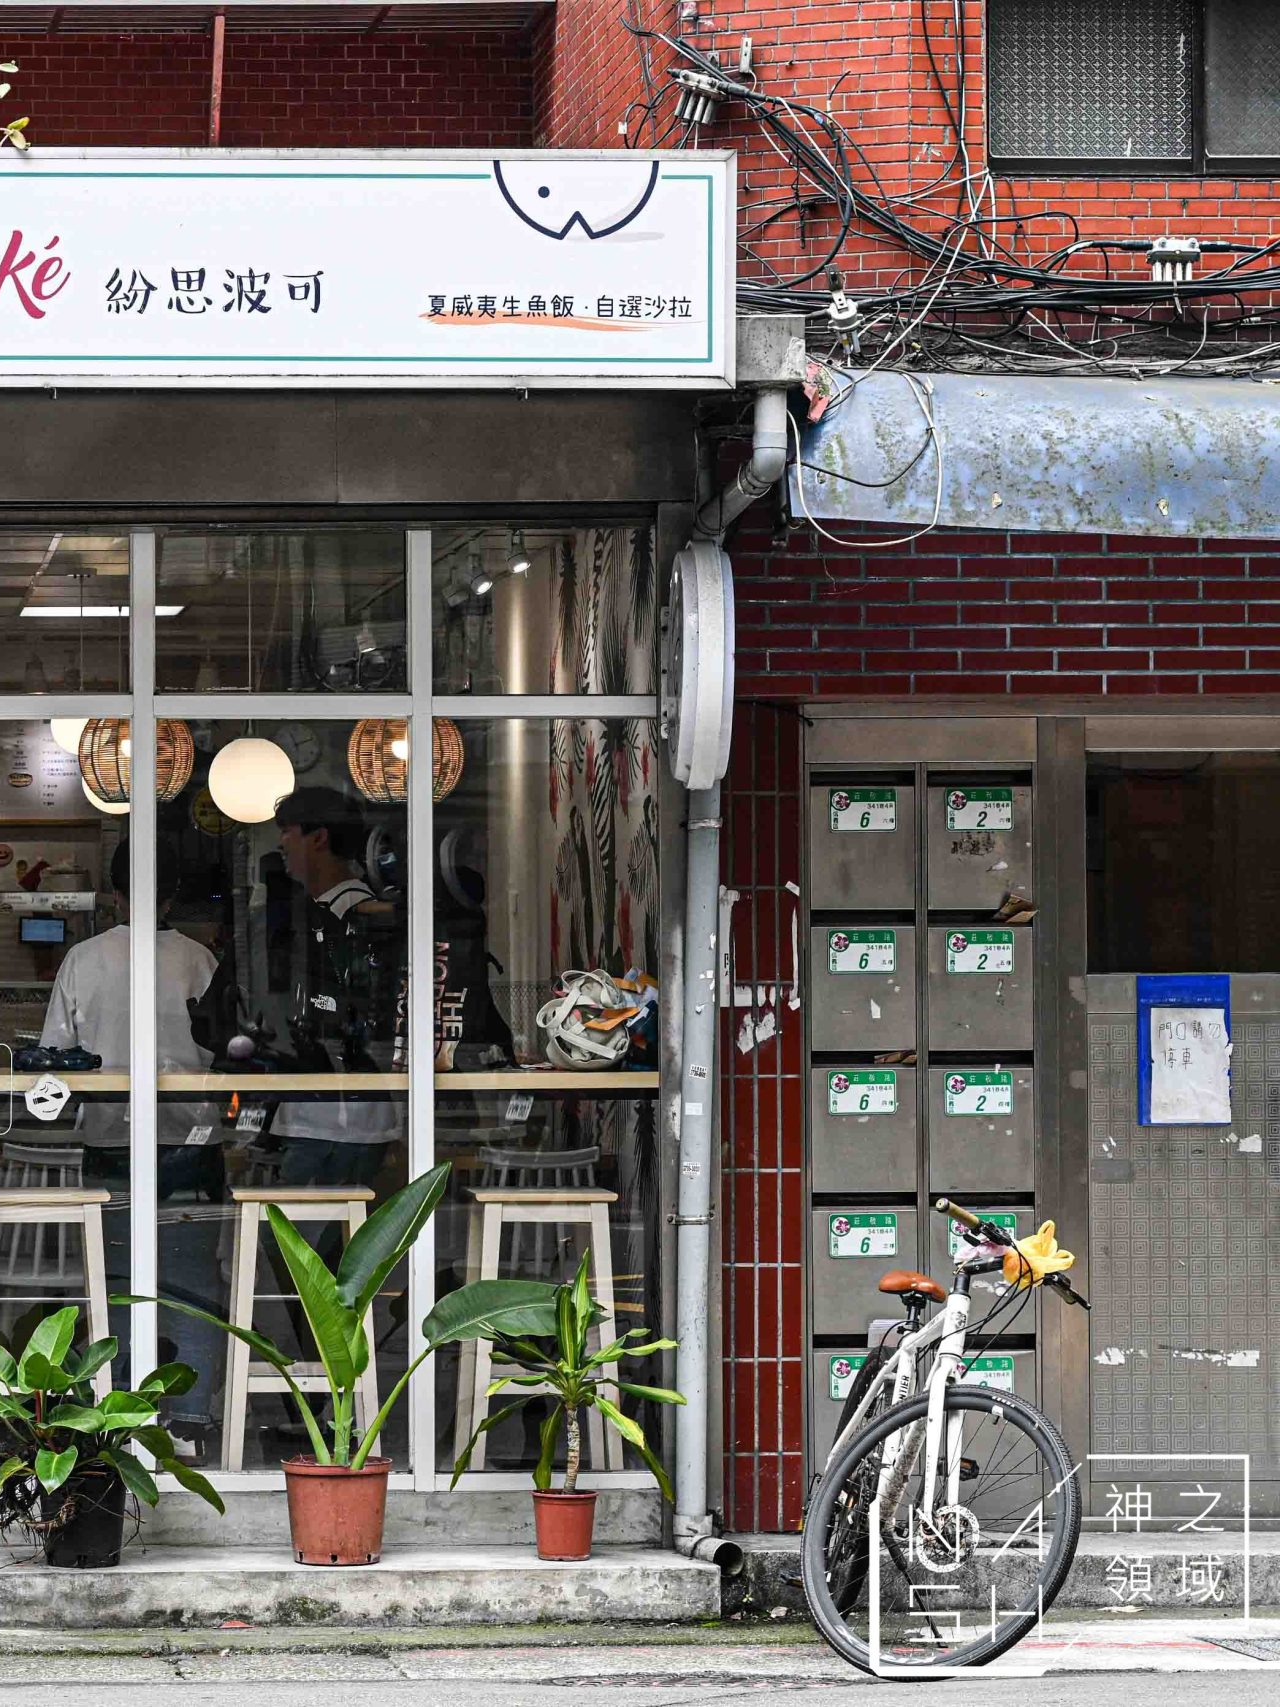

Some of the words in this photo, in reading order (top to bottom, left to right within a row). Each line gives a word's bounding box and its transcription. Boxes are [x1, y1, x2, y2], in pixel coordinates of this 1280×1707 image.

[104, 266, 325, 315] 紛思波可
[860, 811, 871, 828] 6
[976, 811, 988, 828] 2
[858, 952, 870, 970] 6
[976, 953, 988, 970] 2
[441, 987, 468, 1038] THE
[859, 1093, 870, 1111] 6
[975, 1095, 987, 1112] 2
[860, 1236, 871, 1254] 6
[898, 1374, 910, 1400] NTIER
